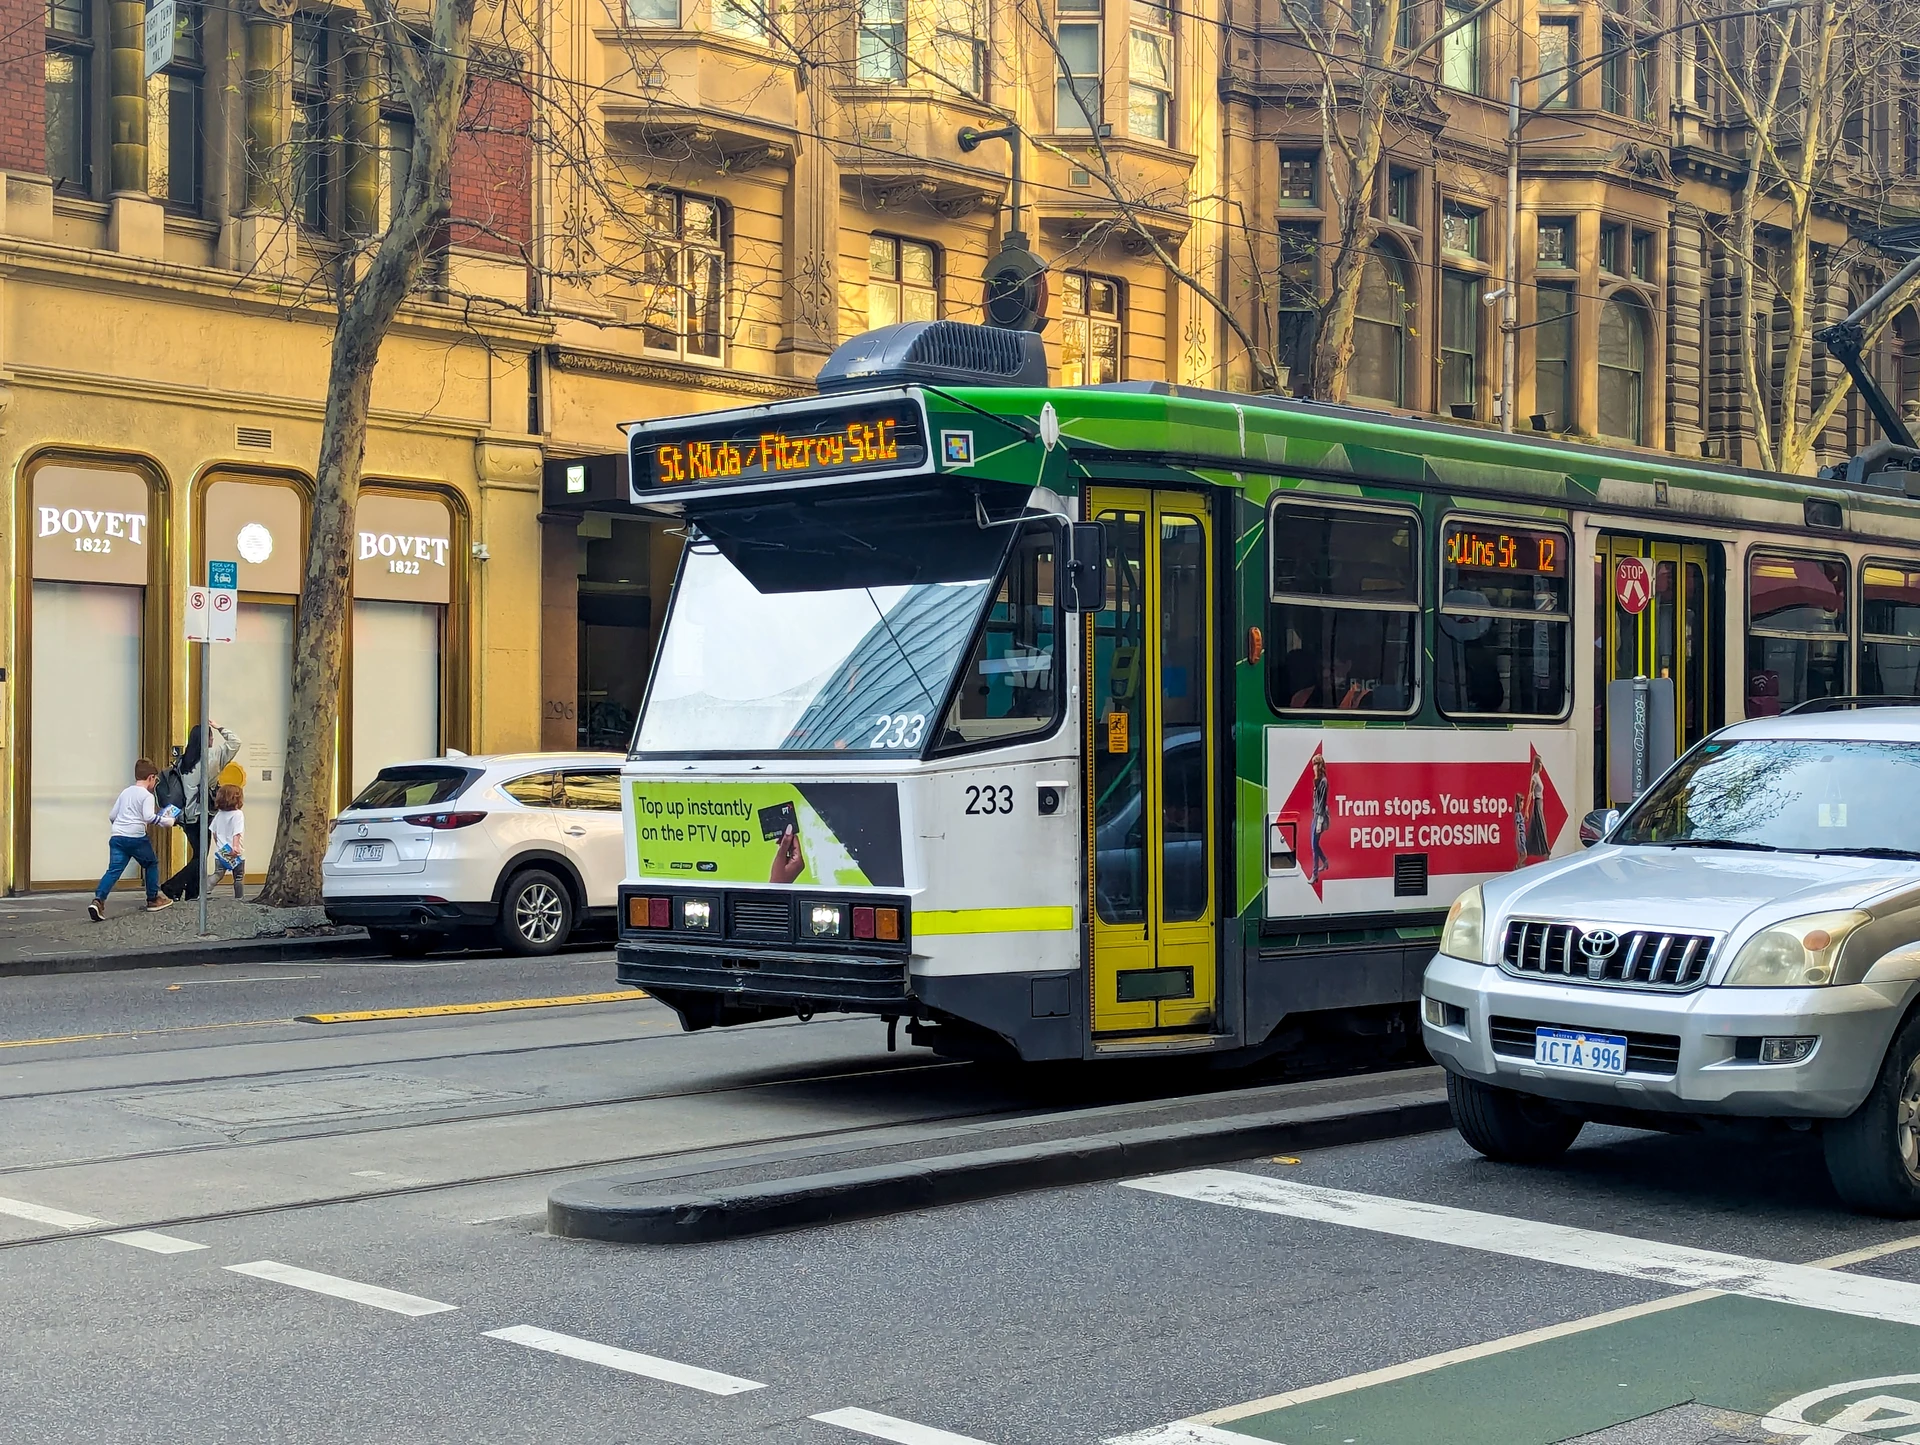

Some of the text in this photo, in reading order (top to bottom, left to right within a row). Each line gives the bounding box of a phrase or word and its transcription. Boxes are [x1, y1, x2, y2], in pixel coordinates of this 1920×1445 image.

[160, 22, 171, 41] LEFT
[152, 45, 163, 65] ONLY
[659, 445, 684, 481] St
[688, 441, 741, 478] Kilda
[761, 433, 843, 471] Fitzroy
[38, 507, 146, 545] BOVET
[74, 537, 111, 554] 1822
[358, 532, 449, 567] BOVET
[1498, 535, 1517, 569] St
[1538, 538, 1555, 572] 12
[389, 560, 420, 575] 1822
[1620, 564, 1644, 580] STOP
[544, 700, 574, 720] 296
[870, 715, 926, 749] 233
[638, 796, 753, 820] Top up instantly
[965, 785, 1014, 815] 233
[1335, 793, 1513, 821] Tram stops. You stop.
[641, 827, 658, 841] on
[661, 824, 684, 842] the
[687, 824, 717, 843] PTV
[720, 827, 751, 847] app
[1350, 823, 1501, 849] PEOPLE CROSSING
